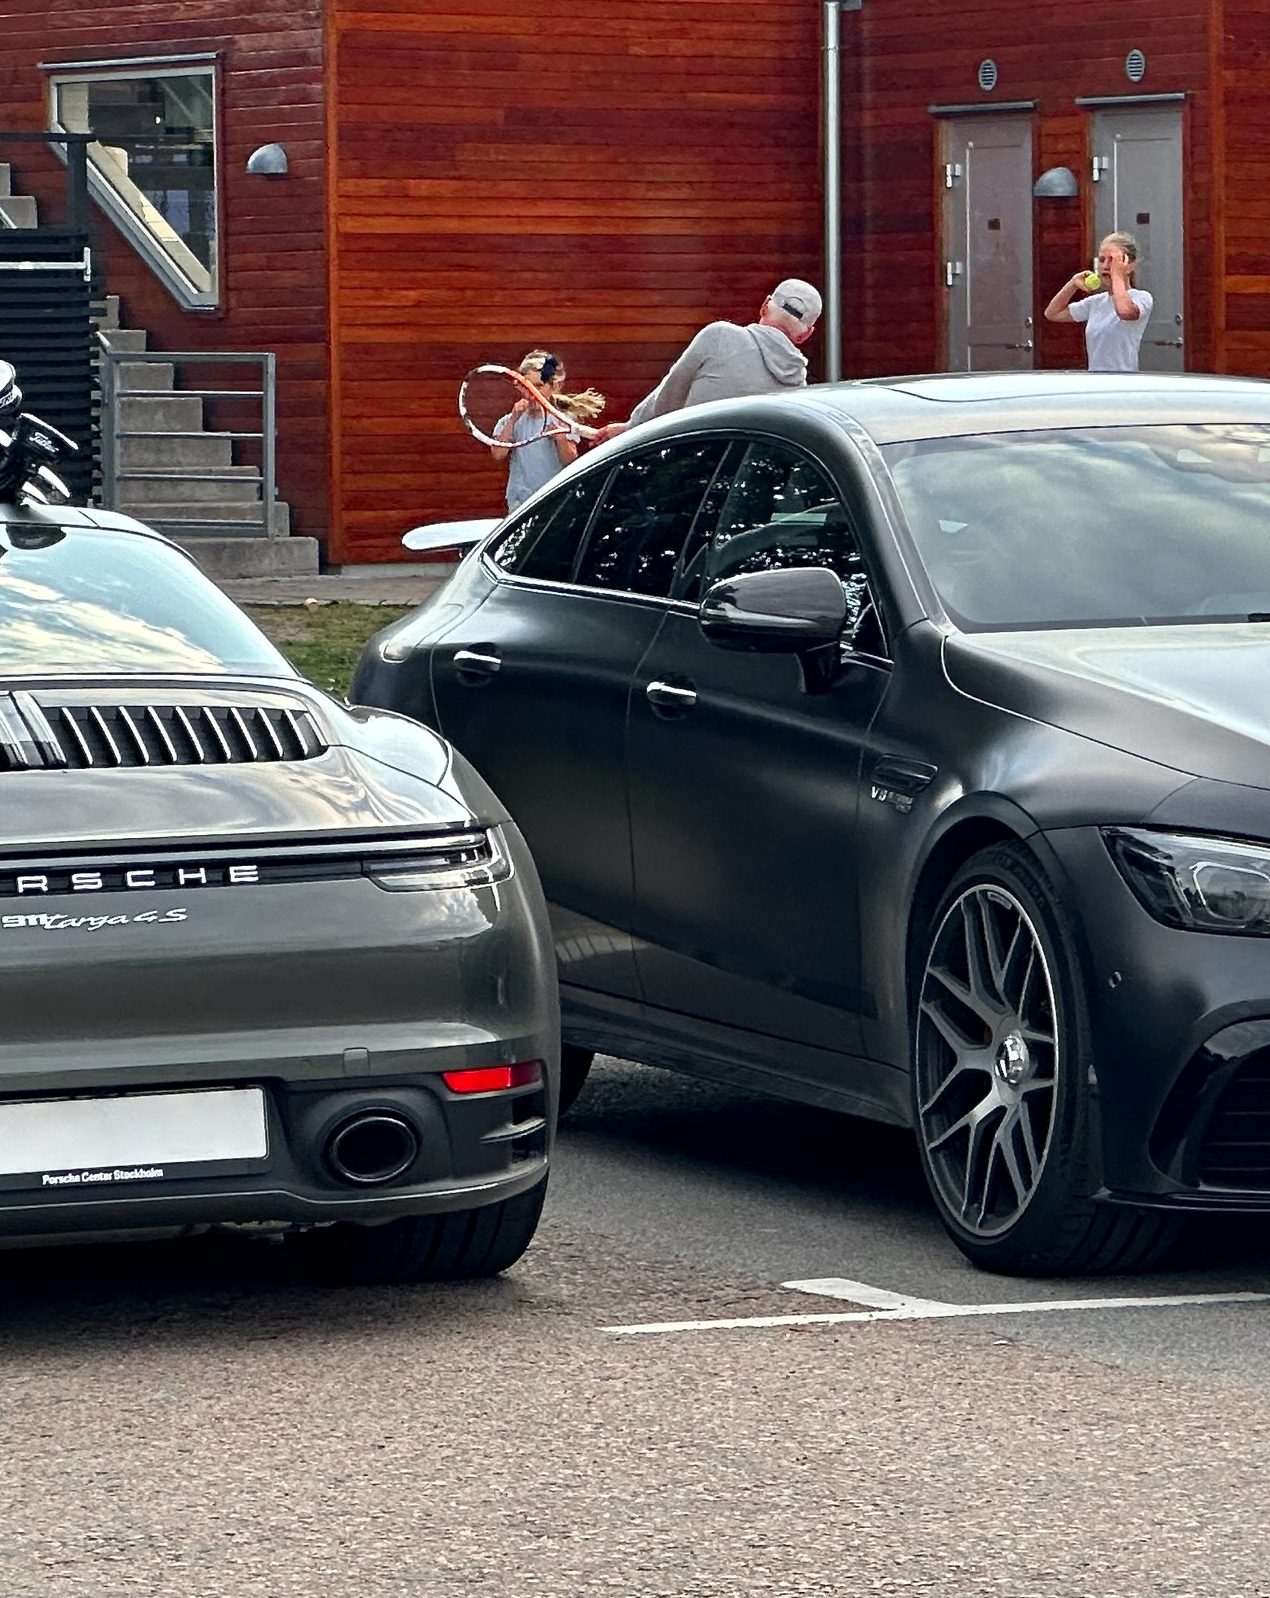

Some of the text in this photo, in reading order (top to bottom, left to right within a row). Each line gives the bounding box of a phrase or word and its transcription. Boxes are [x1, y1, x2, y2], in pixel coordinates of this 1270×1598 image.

[16, 865, 259, 893] RSCHE
[44, 913, 130, 932] targa
[42, 1168, 163, 1185] Porsche Center Stockholm
